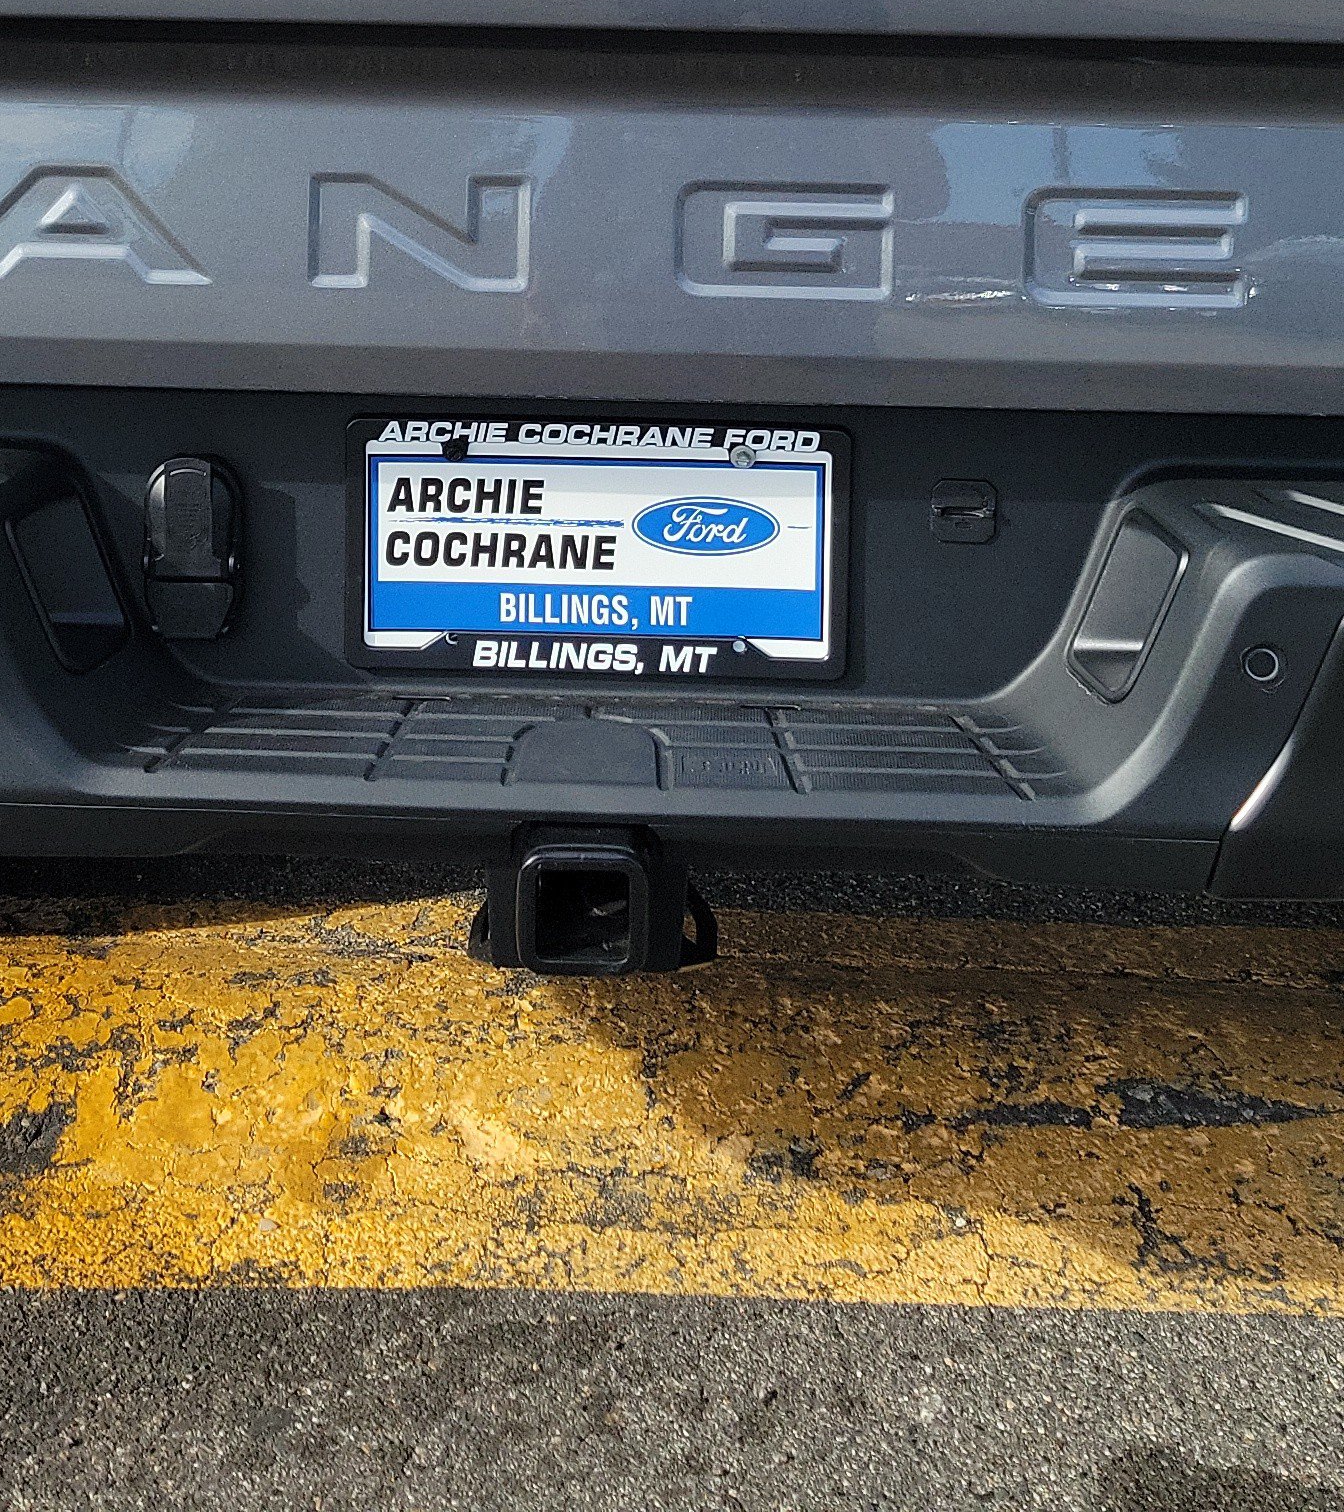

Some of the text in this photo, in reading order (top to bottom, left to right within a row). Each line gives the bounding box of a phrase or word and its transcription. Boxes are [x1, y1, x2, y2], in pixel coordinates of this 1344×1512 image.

[379, 421, 821, 453] ARCHIE COCHRANE FORD
[386, 477, 545, 515] ARCHIE
[663, 504, 749, 545] Ford
[386, 530, 618, 571] COCHRANE
[499, 592, 693, 631] BILLINGS, MT
[472, 639, 718, 675] BILLINGS, MT
